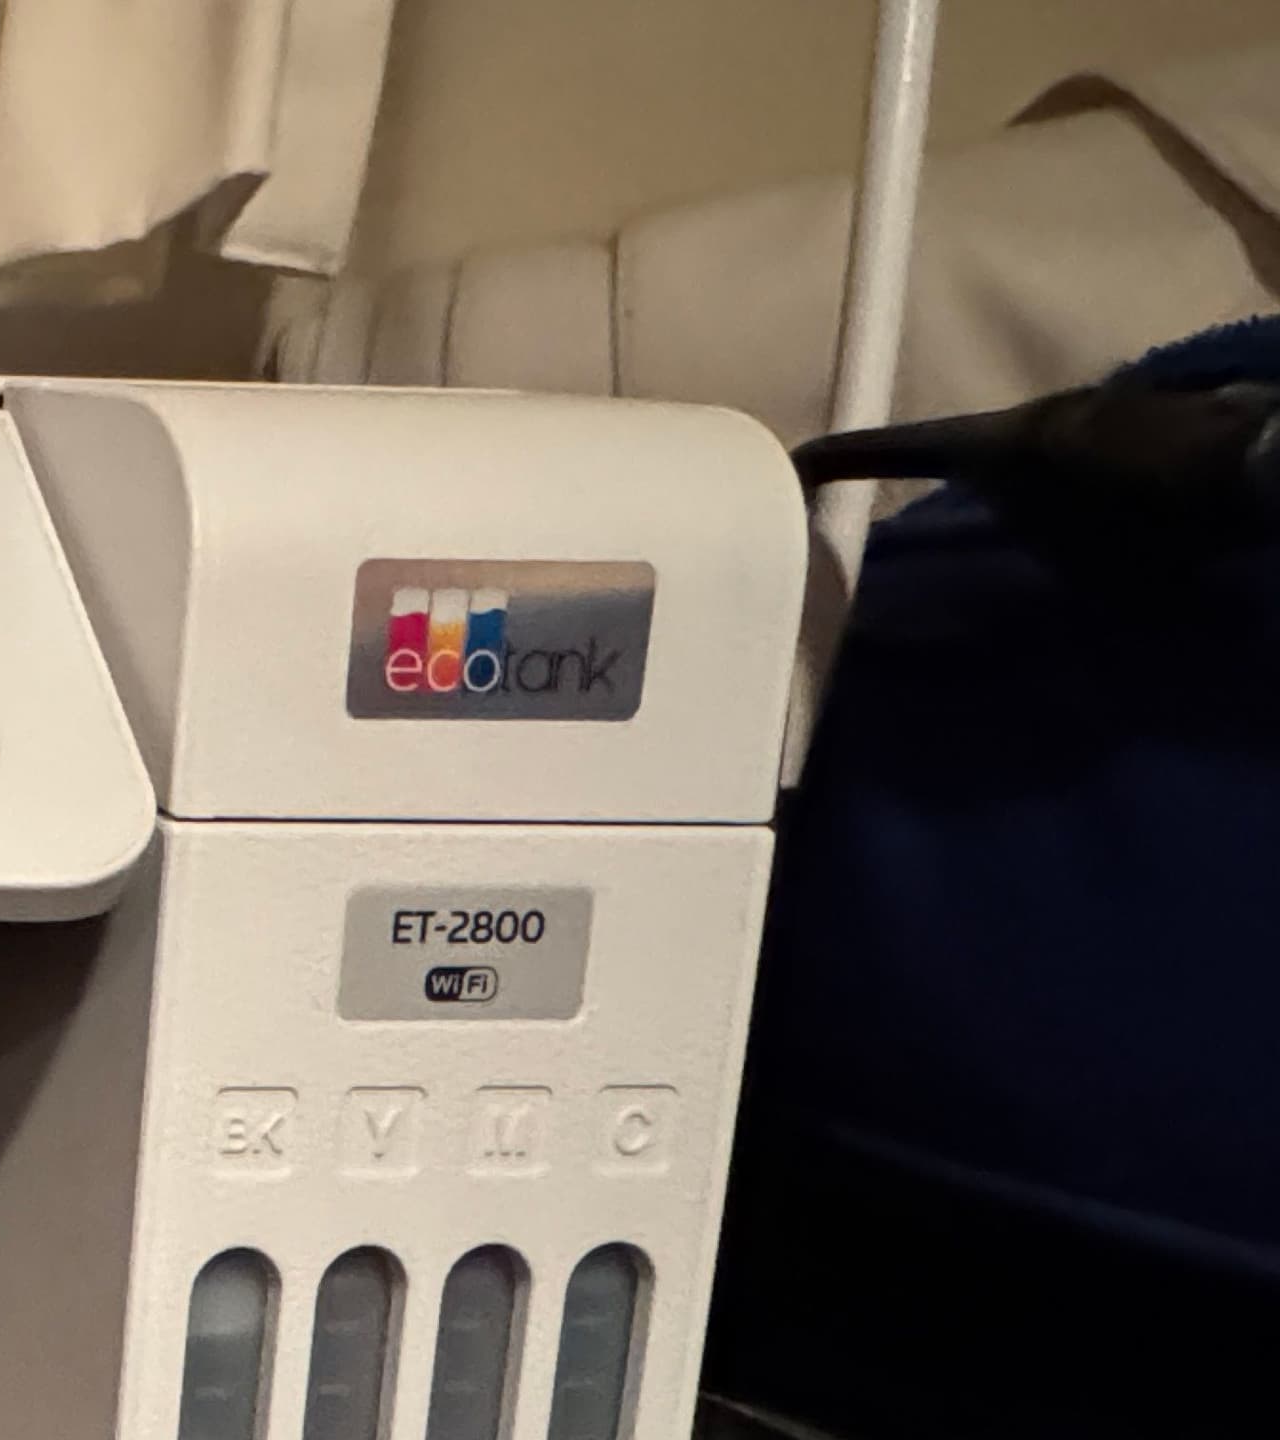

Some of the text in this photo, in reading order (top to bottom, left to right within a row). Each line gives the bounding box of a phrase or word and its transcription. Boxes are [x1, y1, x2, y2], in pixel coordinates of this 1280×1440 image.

[385, 637, 618, 692] ecotank
[392, 910, 546, 944] ET-2800
[219, 1107, 290, 1156] BK
[613, 1104, 654, 1157] C
